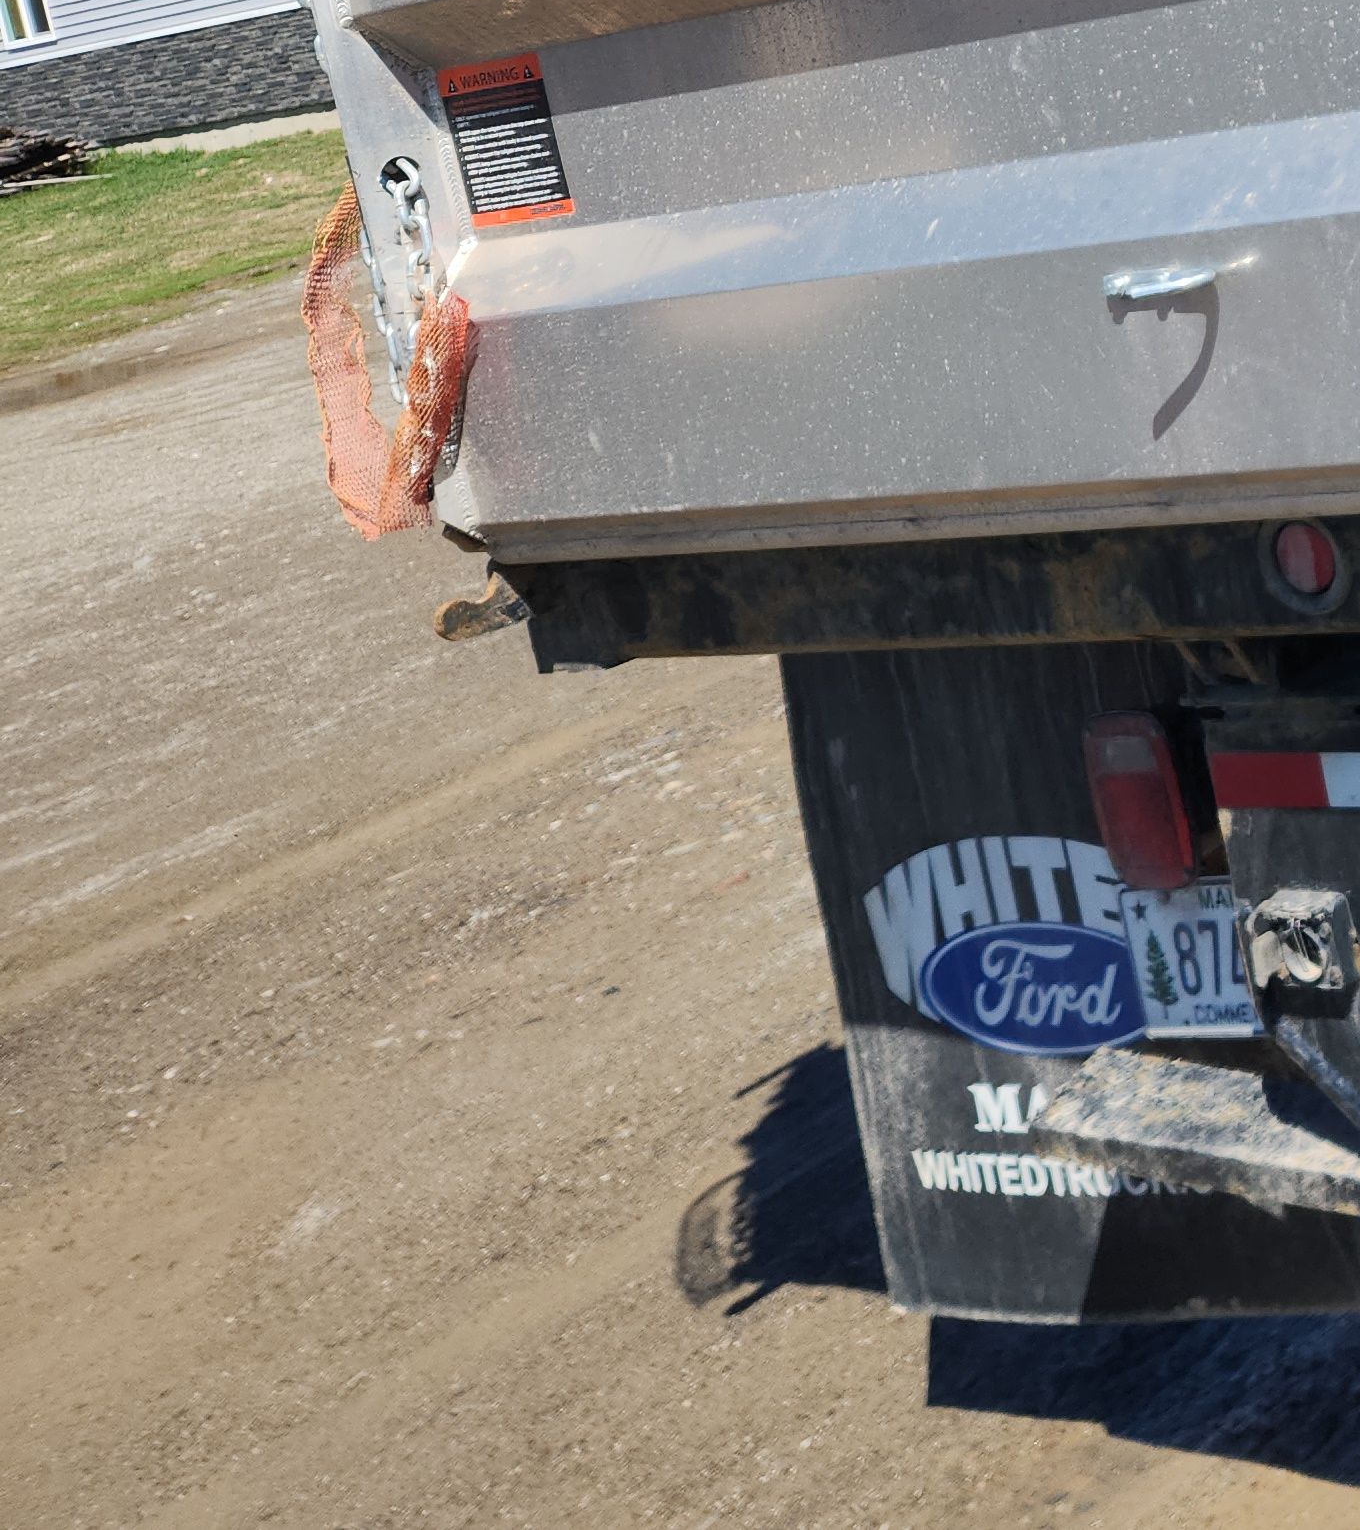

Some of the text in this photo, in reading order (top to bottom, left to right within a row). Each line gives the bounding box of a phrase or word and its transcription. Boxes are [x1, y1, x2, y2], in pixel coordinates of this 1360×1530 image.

[459, 66, 520, 89] WARNING
[1199, 885, 1234, 910] MAI
[863, 834, 1126, 1021] WHITE
[973, 938, 1123, 1028] Ford
[1193, 1001, 1255, 1025] COMME
[966, 1081, 1047, 1134] MA
